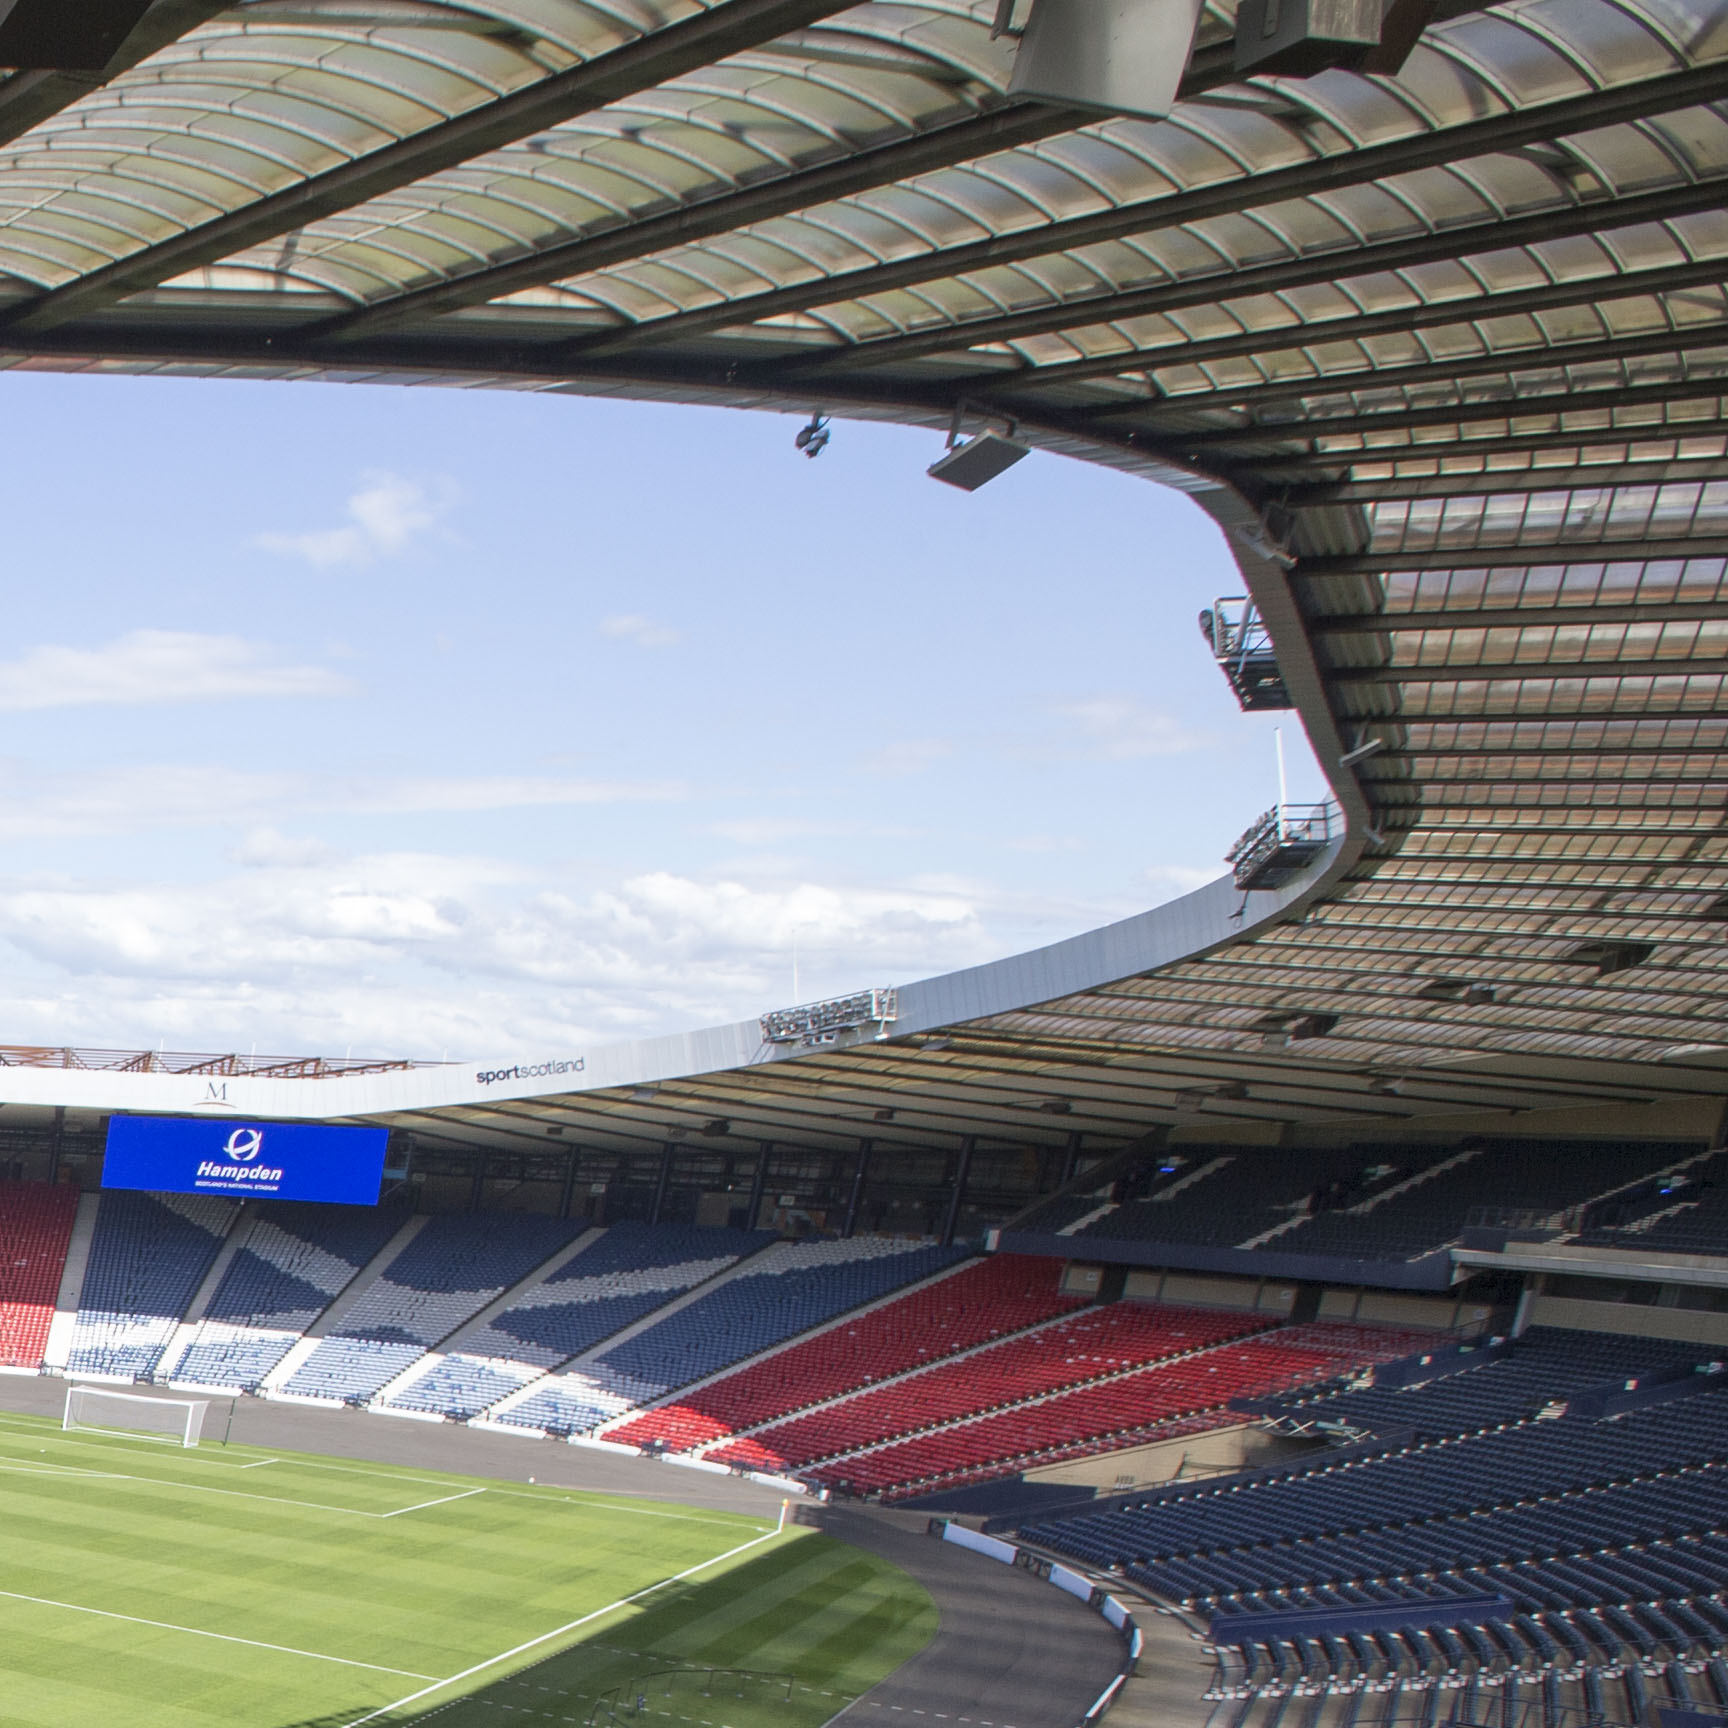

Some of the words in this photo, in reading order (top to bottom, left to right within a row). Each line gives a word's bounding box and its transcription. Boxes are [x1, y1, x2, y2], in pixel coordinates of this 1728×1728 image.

[476, 1057, 584, 1085] sportscotland
[205, 1082, 228, 1101] M
[197, 1161, 283, 1182] Hampden
